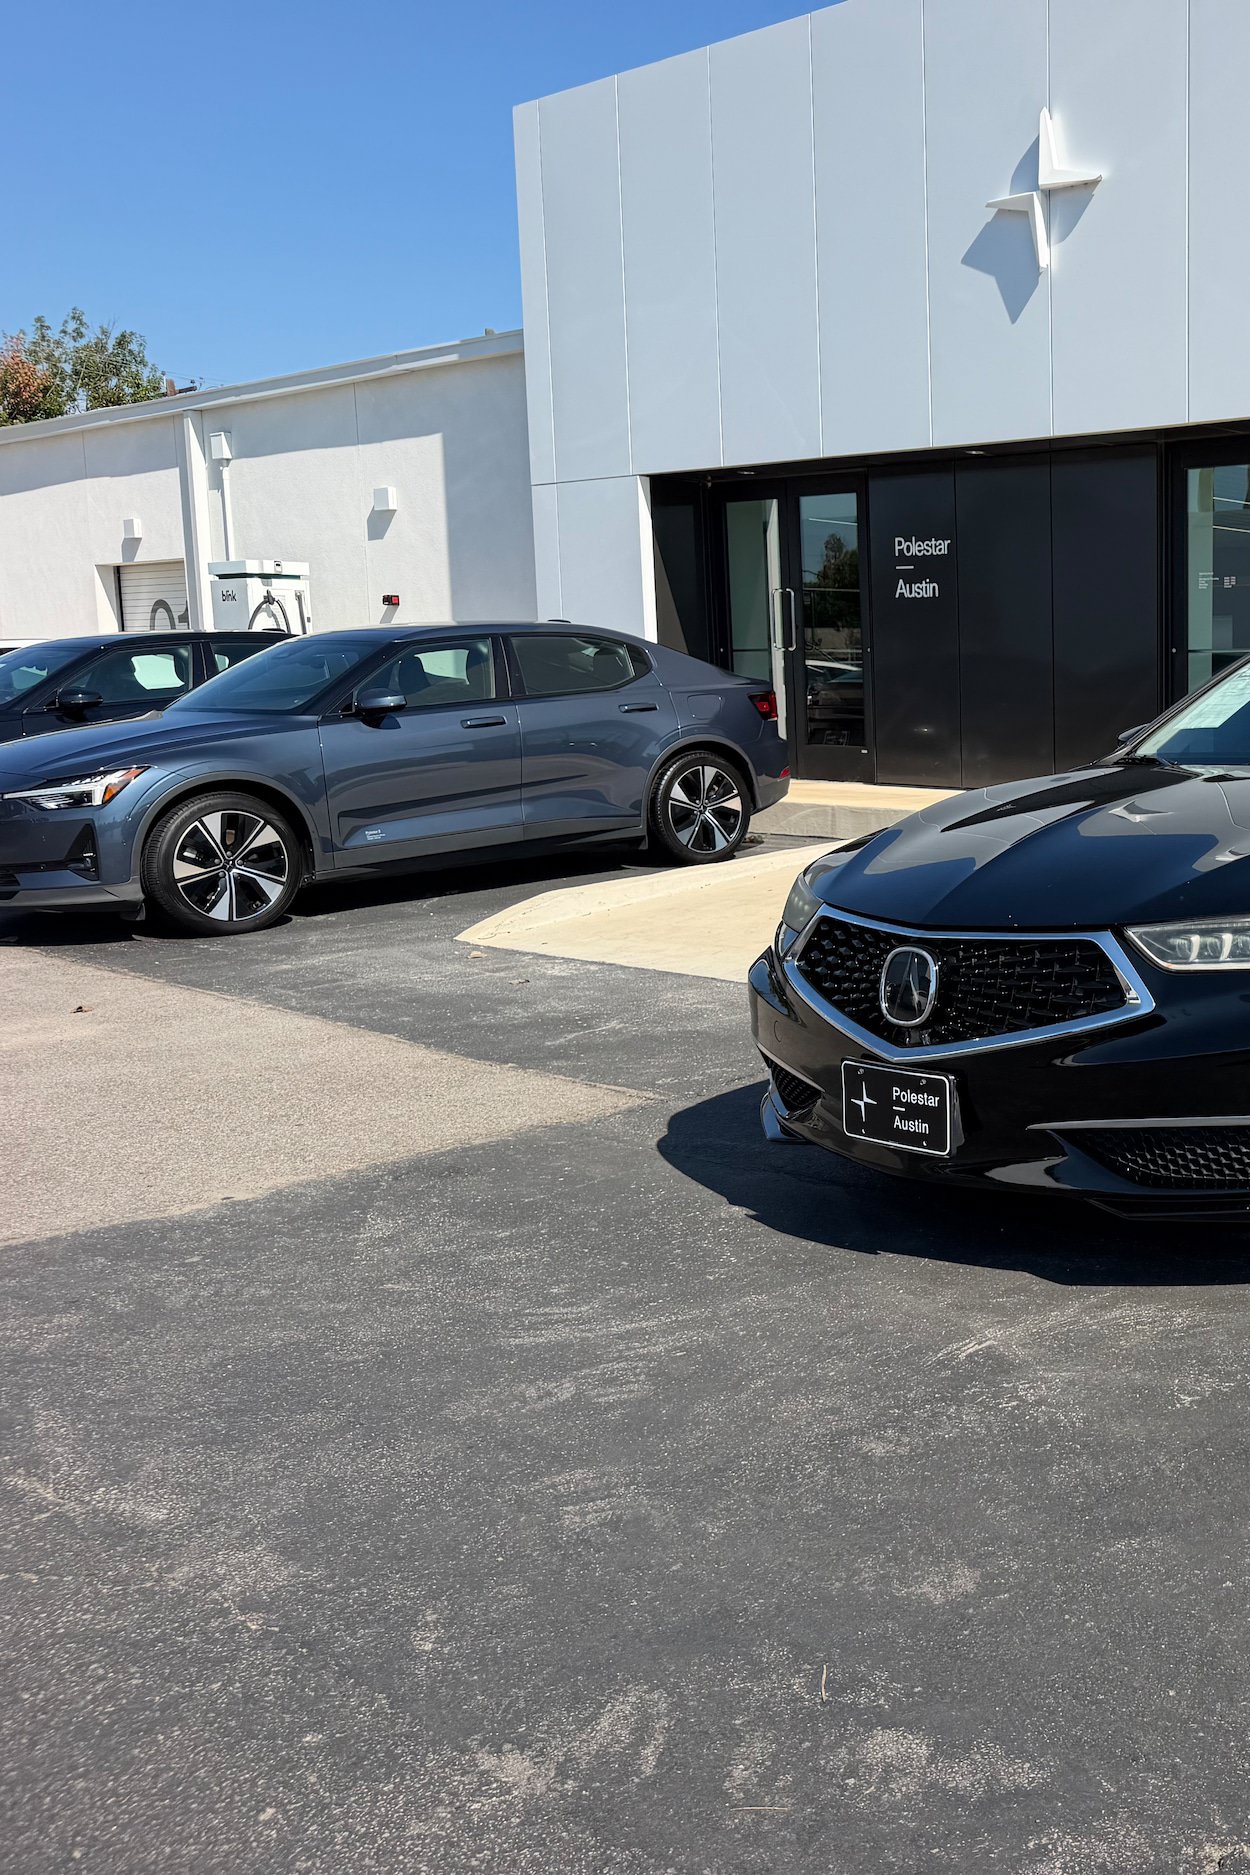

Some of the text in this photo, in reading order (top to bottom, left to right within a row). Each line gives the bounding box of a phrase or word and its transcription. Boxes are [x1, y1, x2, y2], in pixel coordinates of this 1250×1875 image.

[894, 536, 951, 557] Polestar
[221, 590, 237, 602] blink
[895, 578, 939, 598] Austin
[892, 1086, 940, 1107] Polestar
[893, 1115, 929, 1134] Austin
